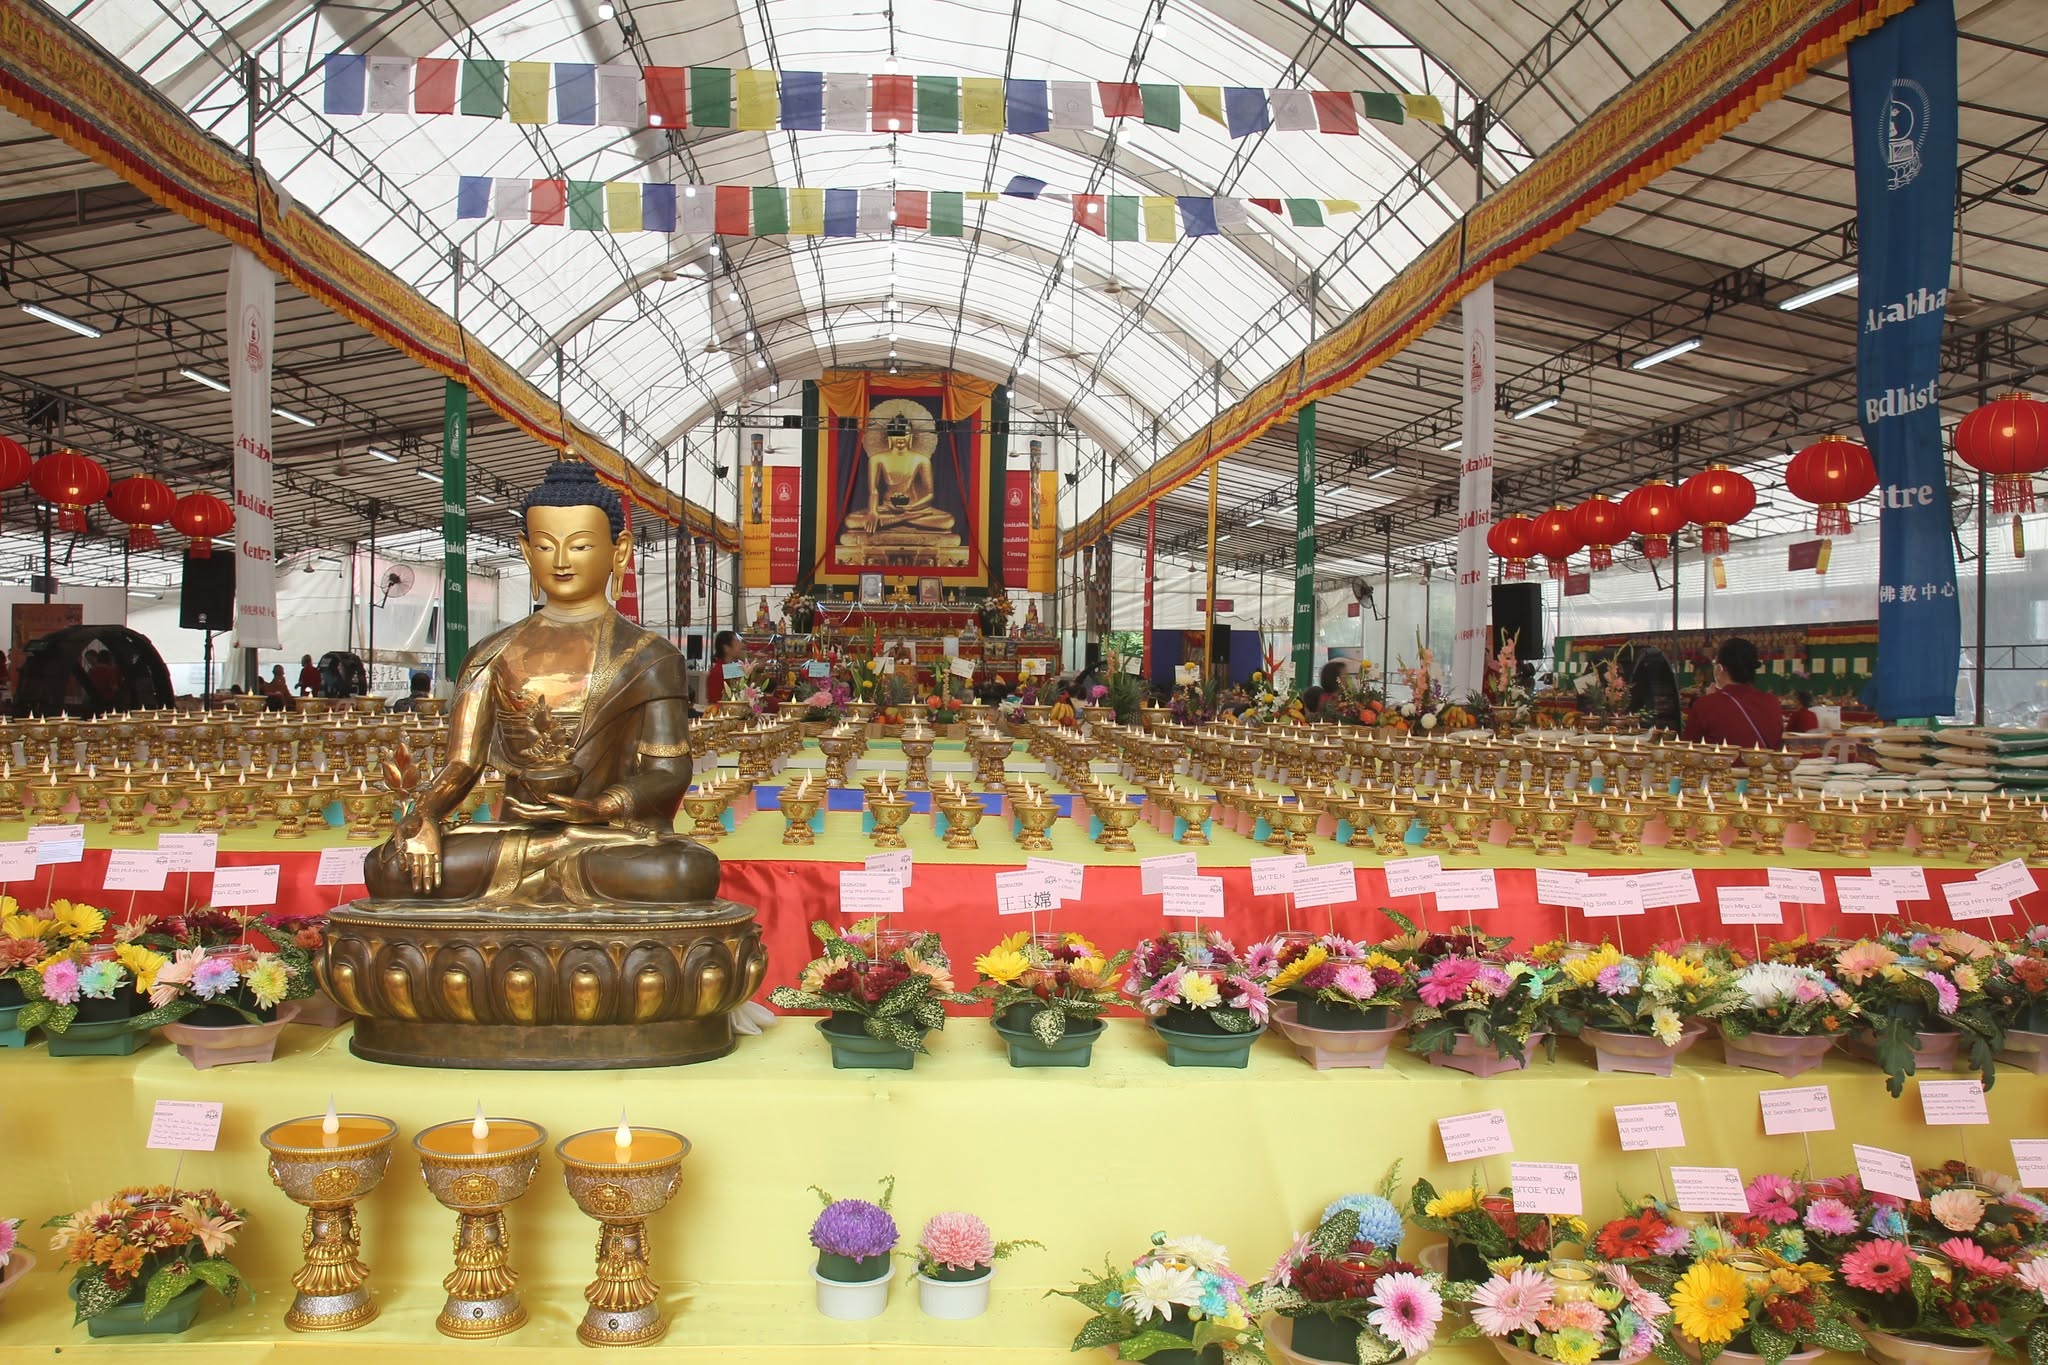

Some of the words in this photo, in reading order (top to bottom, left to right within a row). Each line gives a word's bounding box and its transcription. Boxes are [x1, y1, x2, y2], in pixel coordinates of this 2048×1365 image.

[1405, 885, 1427, 893] family
[1000, 891, 1052, 912] 王玉嫦
[1583, 899, 1595, 907] Ng
[1968, 907, 1994, 915] Family
[1630, 1124, 1665, 1133] sentient
[1460, 1137, 1486, 1148] parents
[1486, 1135, 1500, 1143] Ong
[1622, 1139, 1649, 1148] beings
[1513, 1185, 1541, 1195] SITOE
[1543, 1186, 1566, 1195] YEW
[1514, 1200, 1537, 1209] SING
